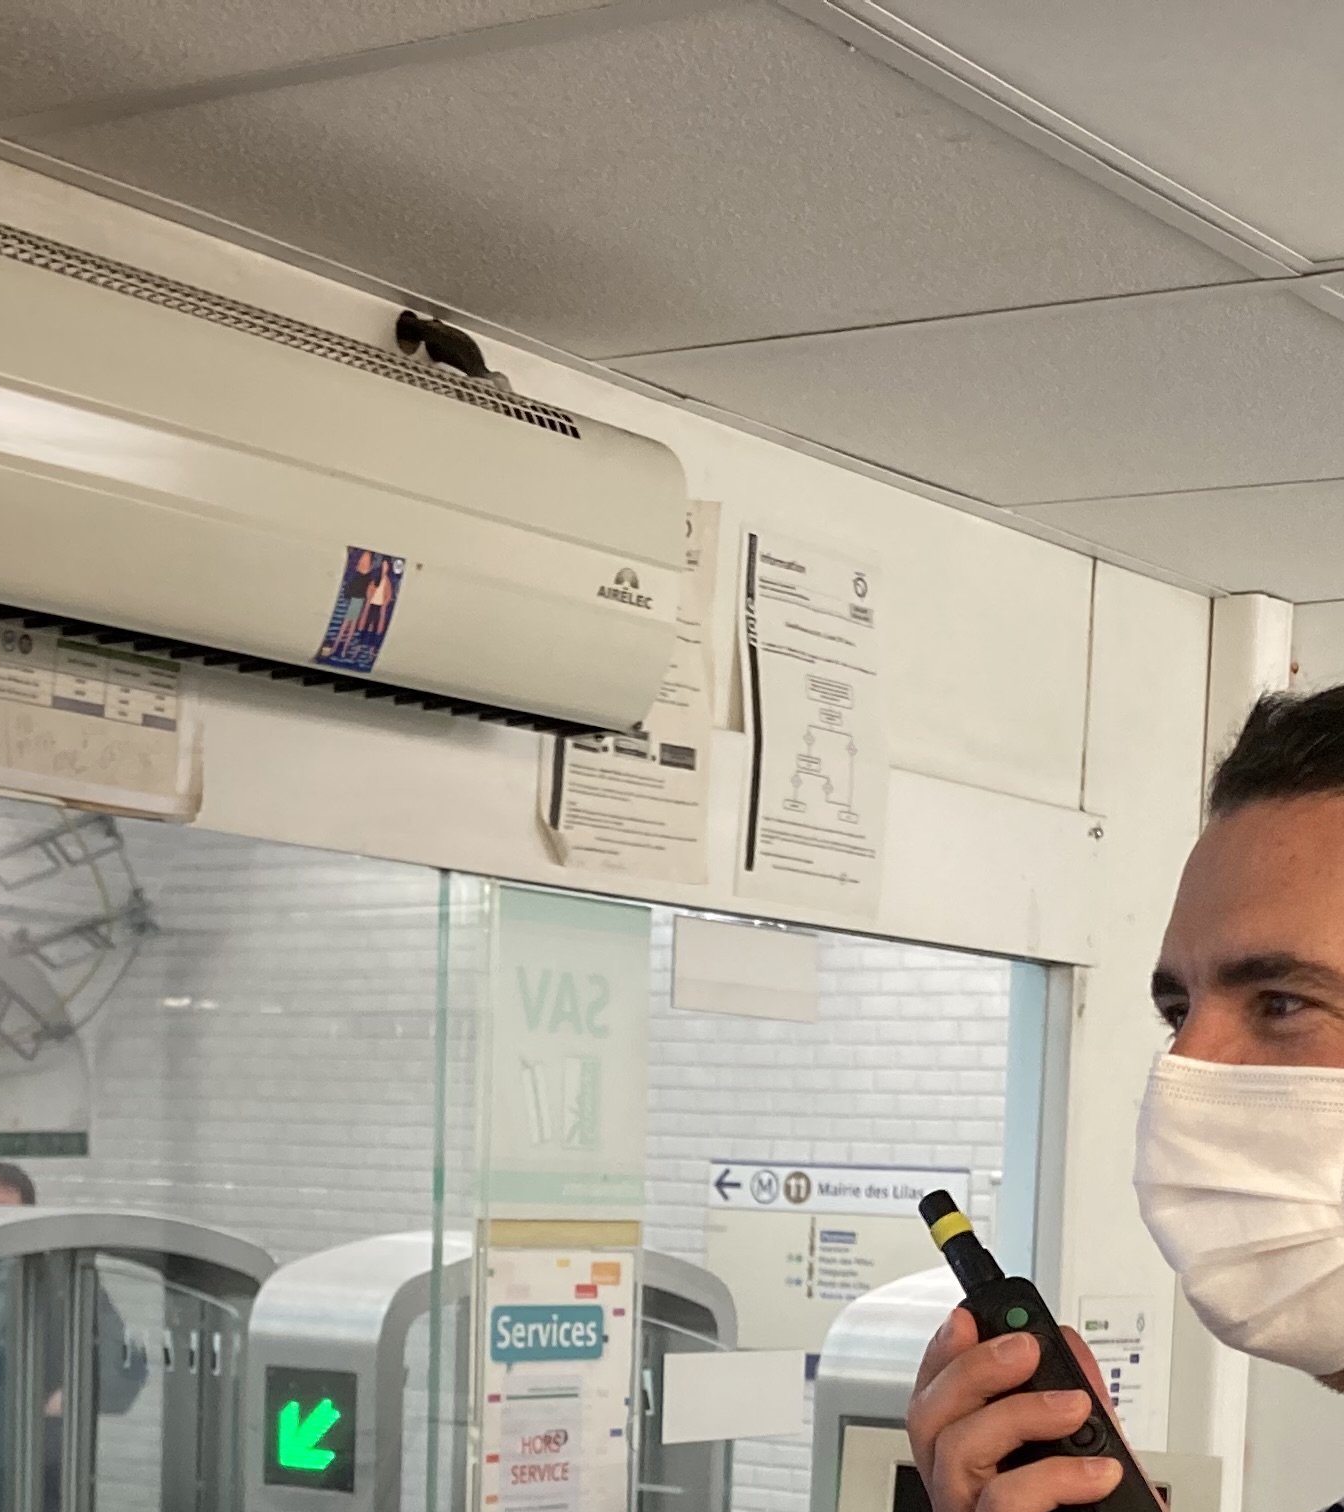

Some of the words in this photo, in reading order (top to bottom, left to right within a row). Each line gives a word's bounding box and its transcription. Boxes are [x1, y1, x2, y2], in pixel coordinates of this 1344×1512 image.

[817, 1181, 860, 1198] Mairie
[864, 1184, 888, 1199] des
[892, 1185, 924, 1200] Lilas
[496, 1314, 597, 1350] Services
[520, 1434, 561, 1455] HORS
[511, 1462, 569, 1485] SERVICE
